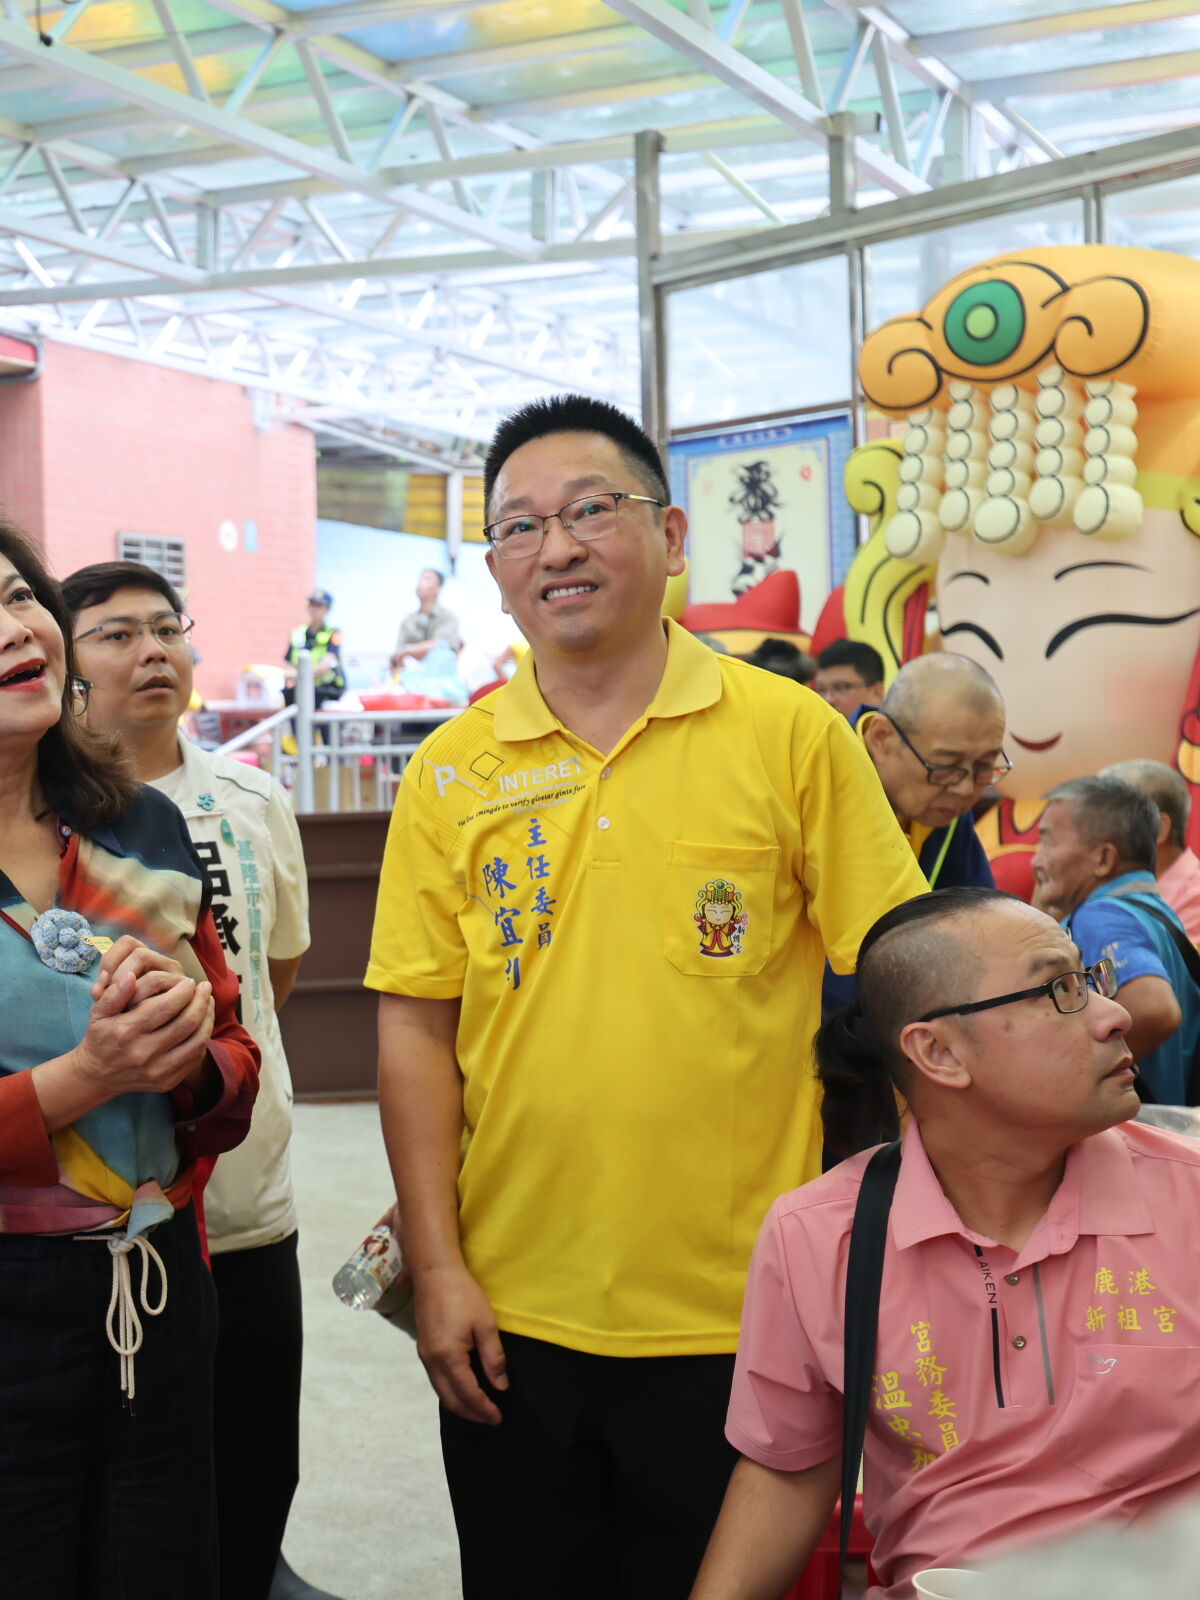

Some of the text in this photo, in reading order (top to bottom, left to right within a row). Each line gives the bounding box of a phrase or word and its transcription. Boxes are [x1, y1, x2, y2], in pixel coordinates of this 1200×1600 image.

[525, 817, 557, 951] 主任委員
[977, 1261, 998, 1304] AIKEN
[1093, 1267, 1159, 1296] 鹿港
[1084, 1304, 1179, 1334] 新祖宮
[910, 1320, 961, 1451] 宮務委員
